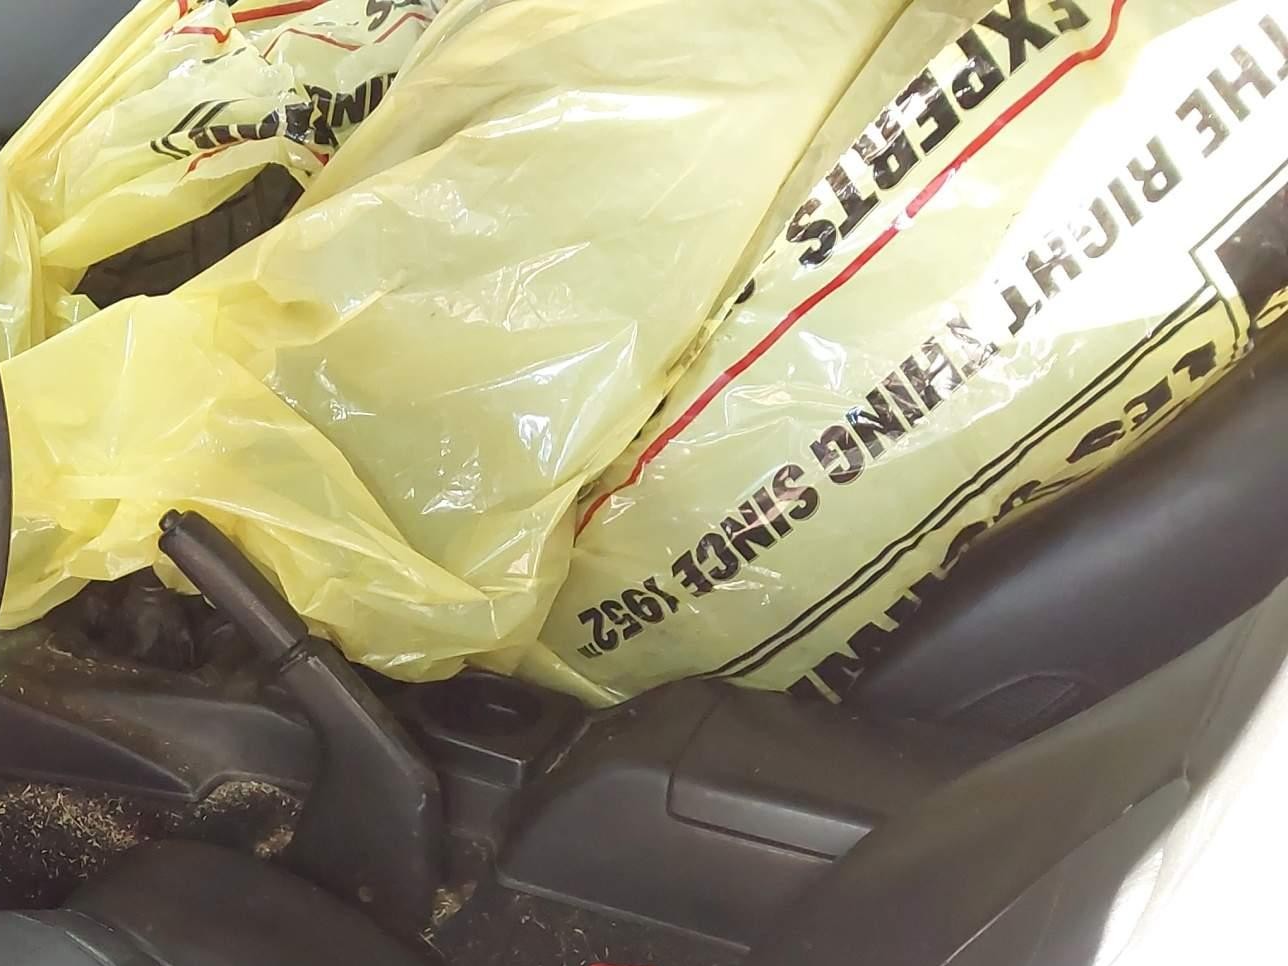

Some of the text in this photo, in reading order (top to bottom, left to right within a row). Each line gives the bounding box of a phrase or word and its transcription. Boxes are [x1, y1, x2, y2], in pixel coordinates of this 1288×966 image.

[995, 136, 1183, 338] RIGHT
[809, 314, 1000, 485] THING
[671, 463, 821, 598] SINCE
